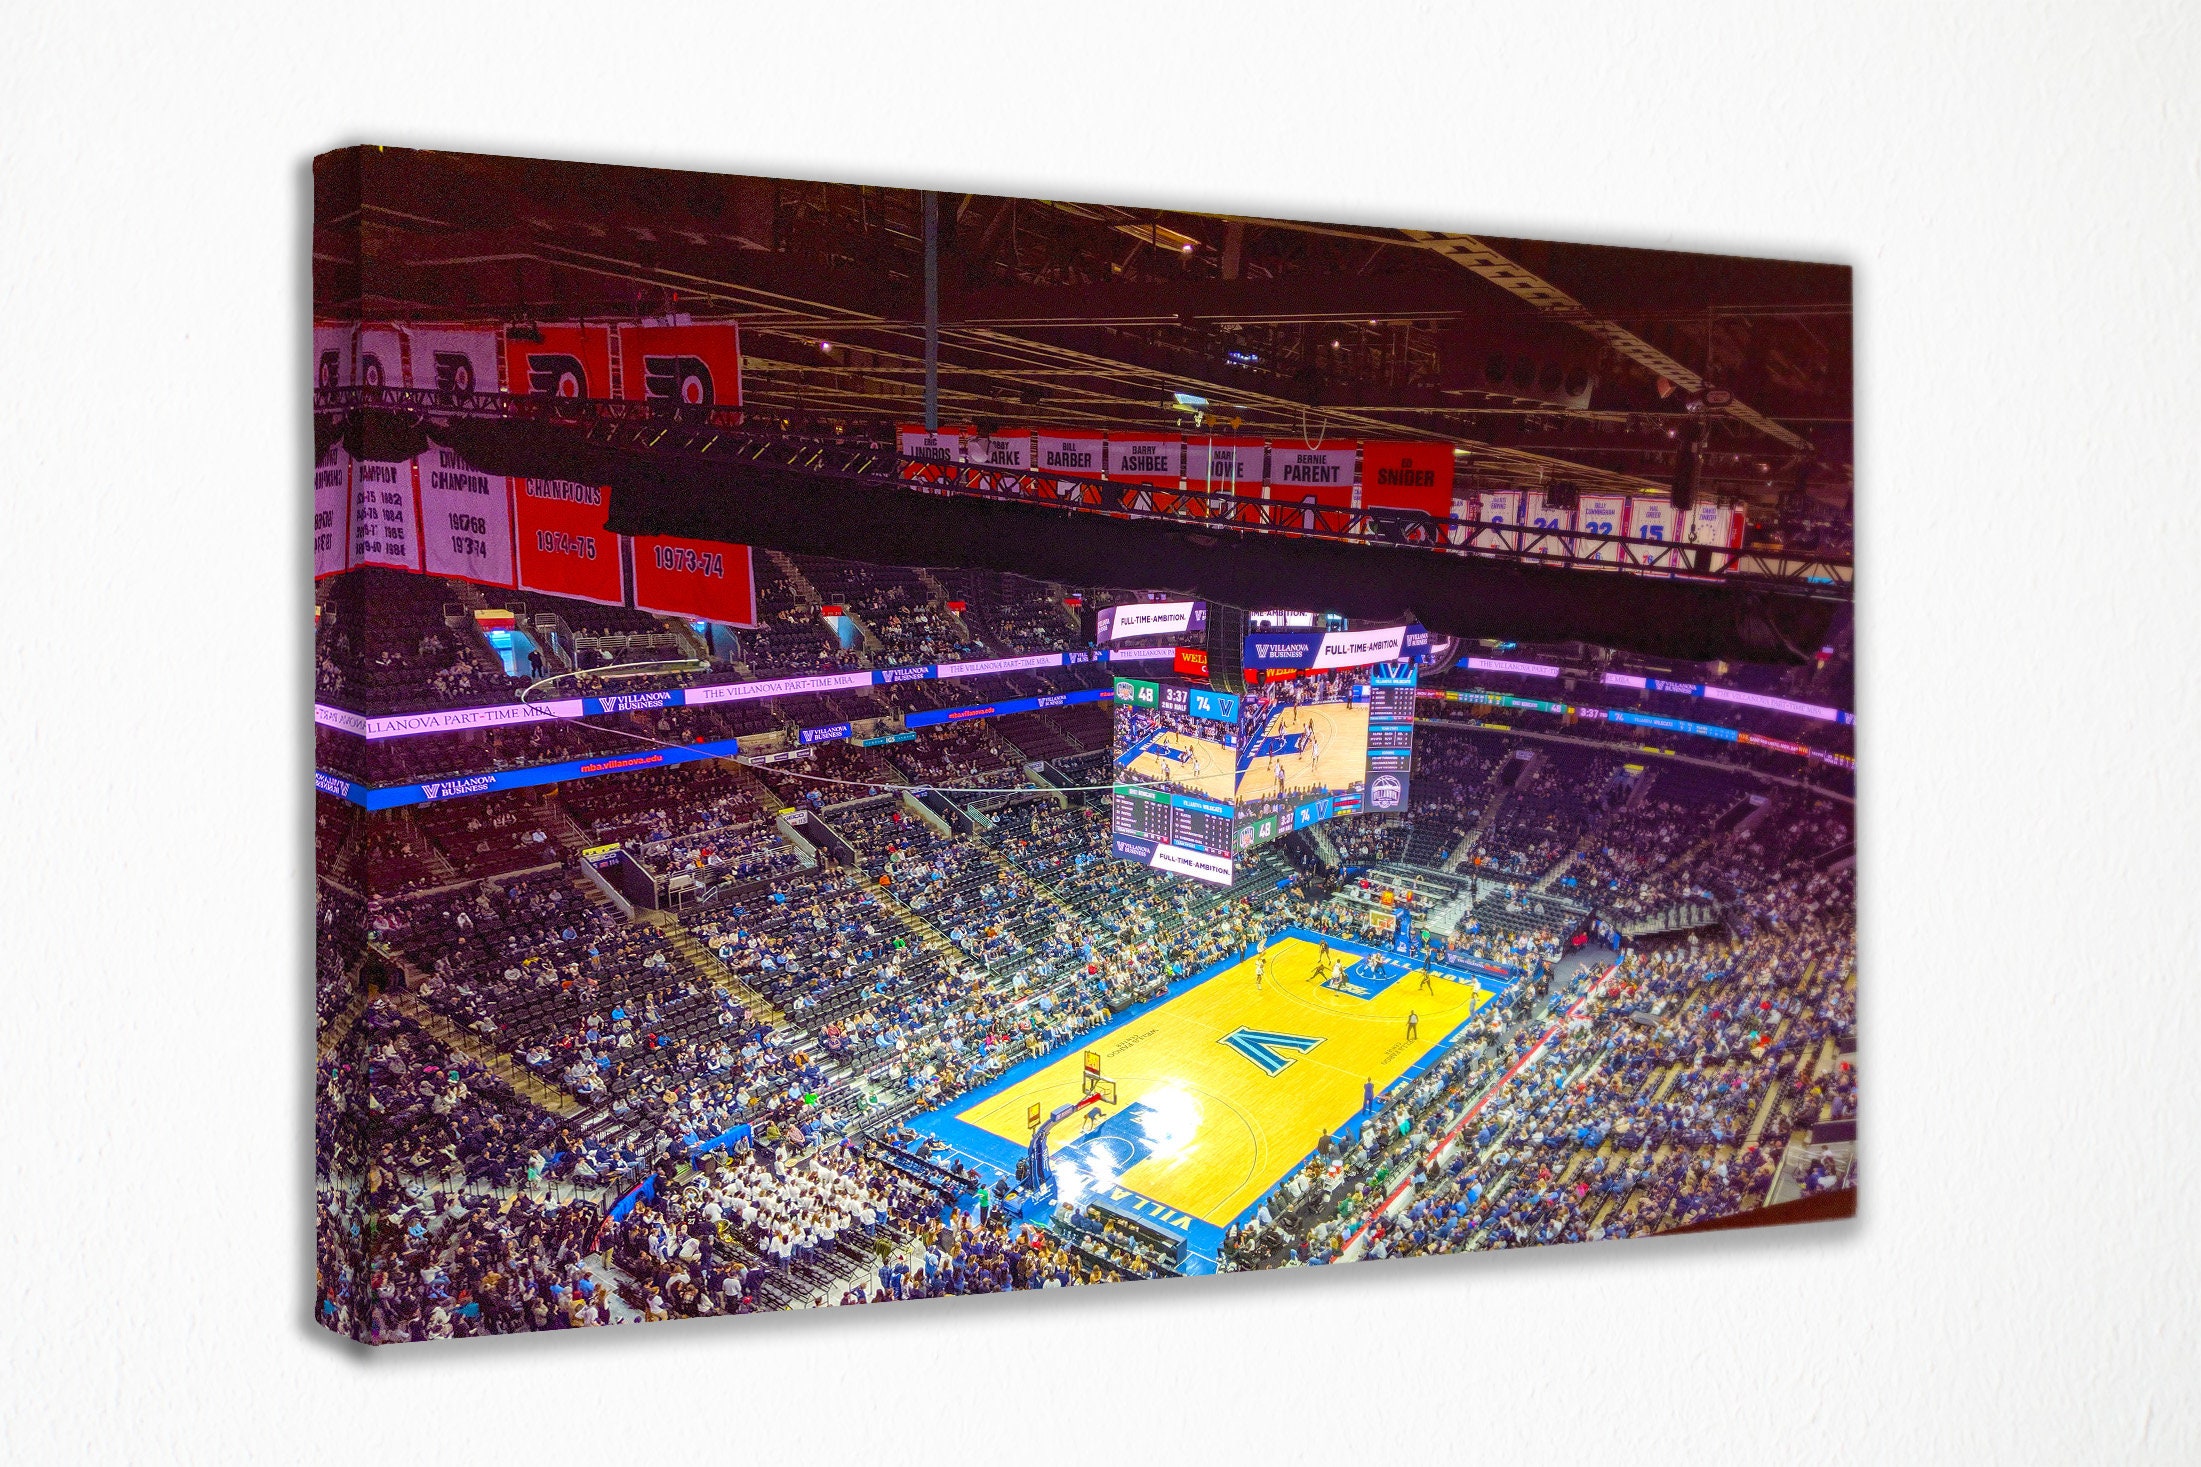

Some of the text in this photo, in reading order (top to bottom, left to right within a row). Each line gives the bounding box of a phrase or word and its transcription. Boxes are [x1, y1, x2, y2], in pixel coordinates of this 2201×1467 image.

[1062, 442, 1076, 452] BILL
[1132, 445, 1156, 455] BARRY
[1046, 452, 1092, 468] BARBER
[1121, 456, 1169, 472] ASHBEE
[1296, 454, 1327, 465] BERNIE
[1401, 458, 1413, 468] ED
[1283, 465, 1340, 483] PARENT
[1377, 469, 1435, 487] SNIDER
[526, 478, 602, 506] CHAMPIONS
[1639, 524, 1664, 541] 15
[536, 530, 597, 561] 1974-75
[653, 545, 725, 578] 1973-74
[1270, 644, 1309, 652] VILLANOVA
[1325, 639, 1399, 655] FULL-TIME-AMBITION.
[895, 667, 929, 676] VILLANOVA
[965, 662, 1002, 672] VILLANOVA
[894, 673, 924, 682] BUSINESS
[703, 689, 725, 699] THE
[727, 684, 781, 697] VILLANOVA
[784, 678, 832, 692] PART-TIME
[1138, 686, 1154, 702] 48
[1166, 688, 1188, 703] 3:37
[616, 691, 672, 703] VILLANOVA
[1196, 695, 1211, 712] 74
[617, 699, 664, 711] BUSINESS
[1580, 707, 1599, 718] 3:37
[444, 709, 519, 725] PART-TIME
[523, 706, 556, 718] MBA.
[814, 725, 847, 735] VILLANOVA
[814, 731, 843, 741] BUSINESS
[580, 754, 663, 773] mba.villanova.edu
[441, 775, 496, 789] VILLANOVA
[442, 783, 488, 797] BUSINESS
[1300, 808, 1310, 823] 74
[1259, 821, 1271, 839] 48
[1159, 853, 1231, 876] FULL-TIME-AMBITION.
